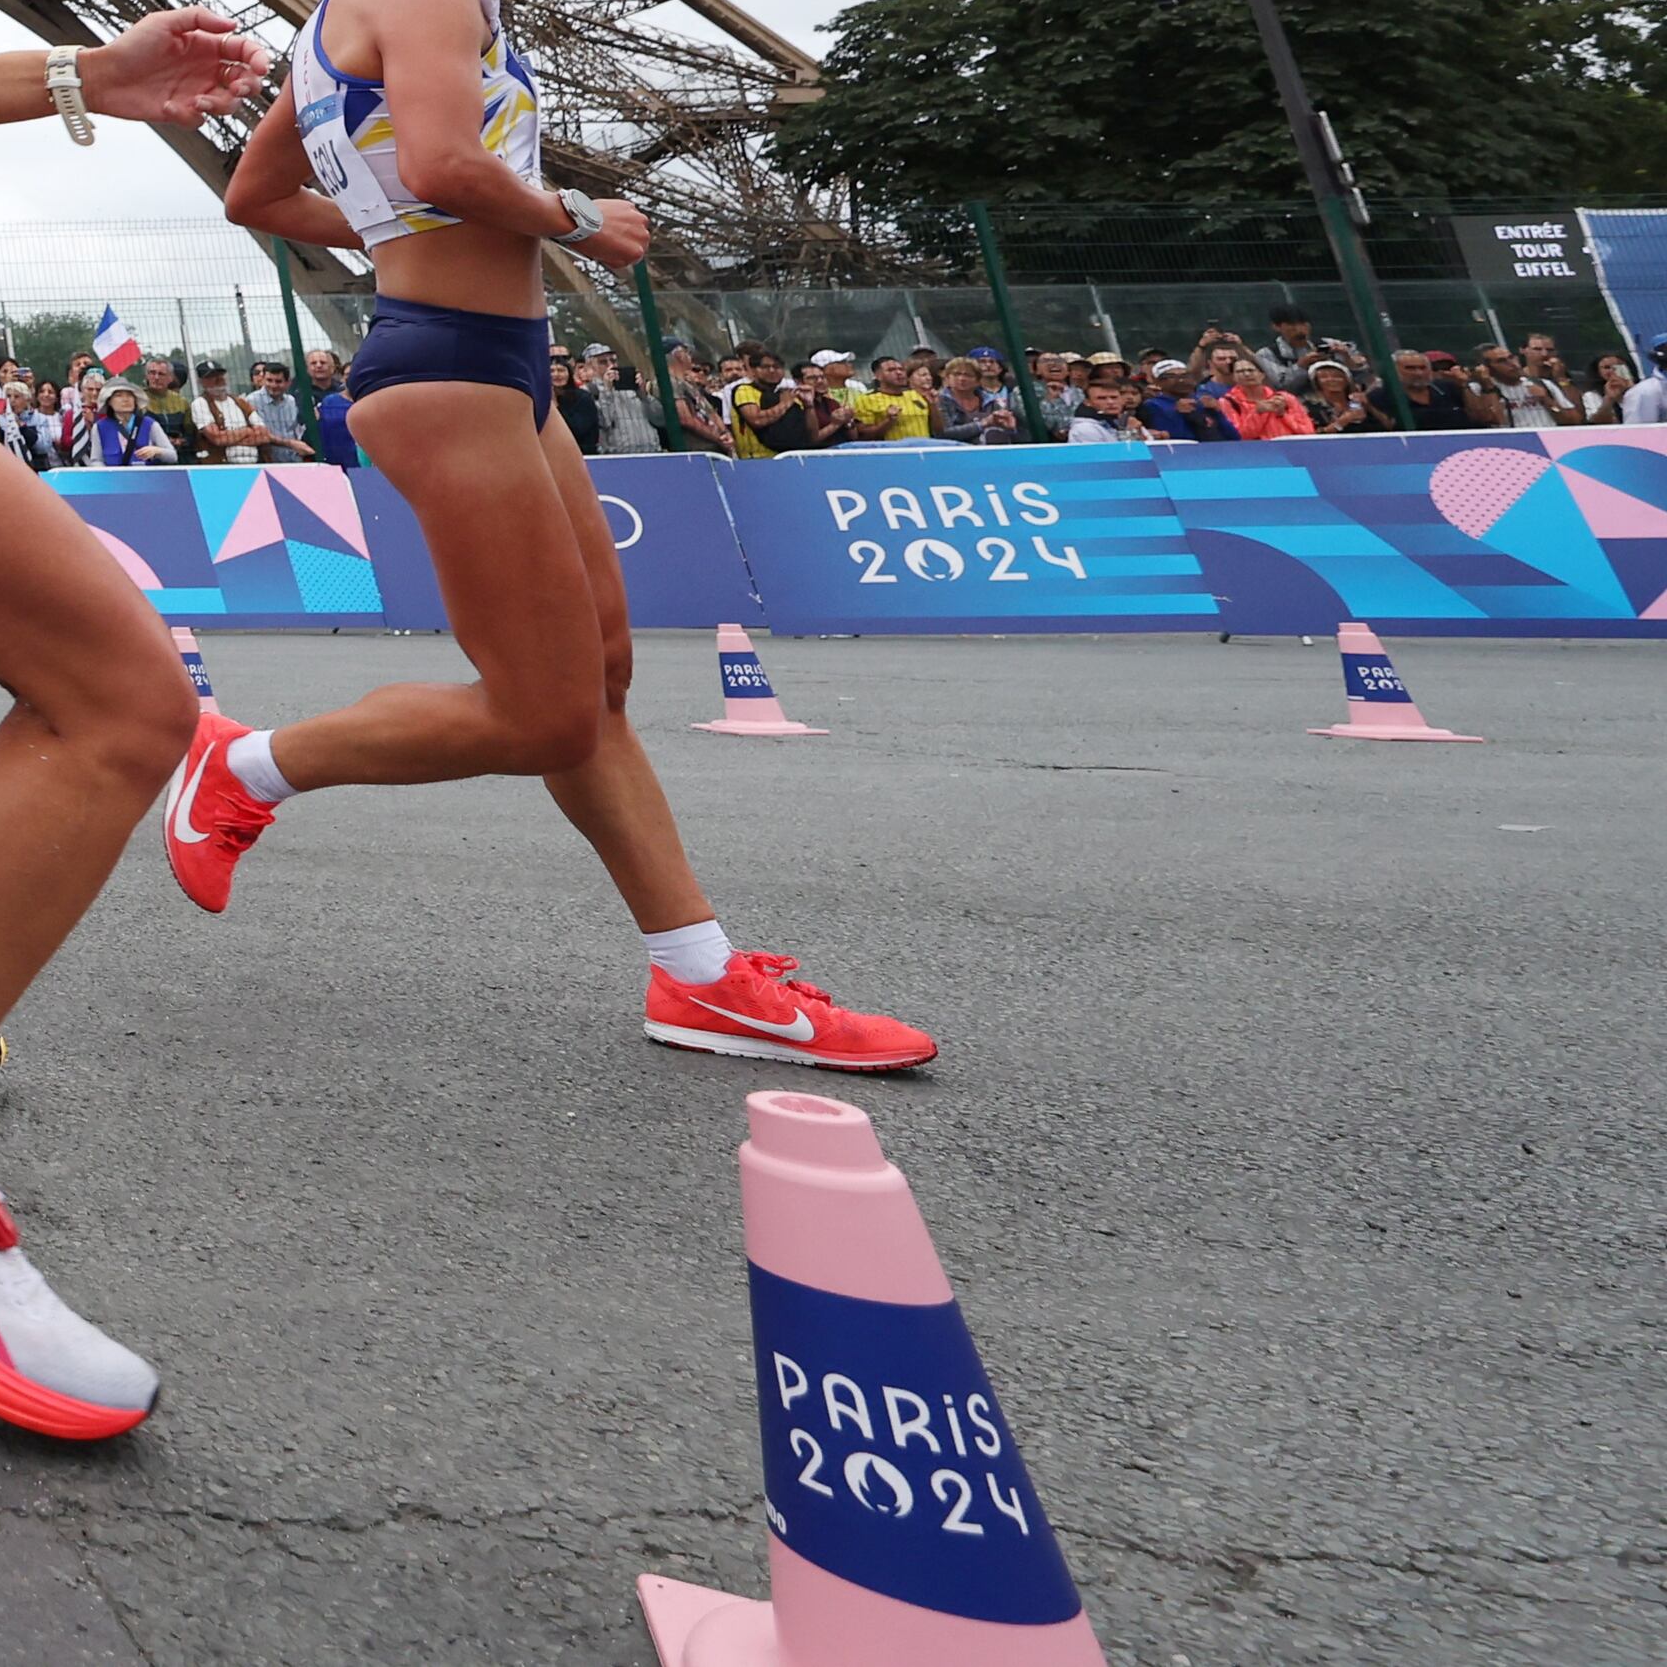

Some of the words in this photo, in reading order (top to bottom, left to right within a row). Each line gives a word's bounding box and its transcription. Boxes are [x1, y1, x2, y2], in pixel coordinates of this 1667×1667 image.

[1494, 221, 1568, 240] ENTRÉE
[1510, 243, 1564, 258] TOUR
[1513, 262, 1576, 277] EIFFEL
[825, 481, 1061, 532] PARIS
[847, 536, 1088, 584] 2024
[723, 663, 764, 676] PARIS
[1363, 678, 1405, 691] 202
[773, 1351, 1001, 1458] PARIS
[790, 1428, 1029, 1536] 2024
